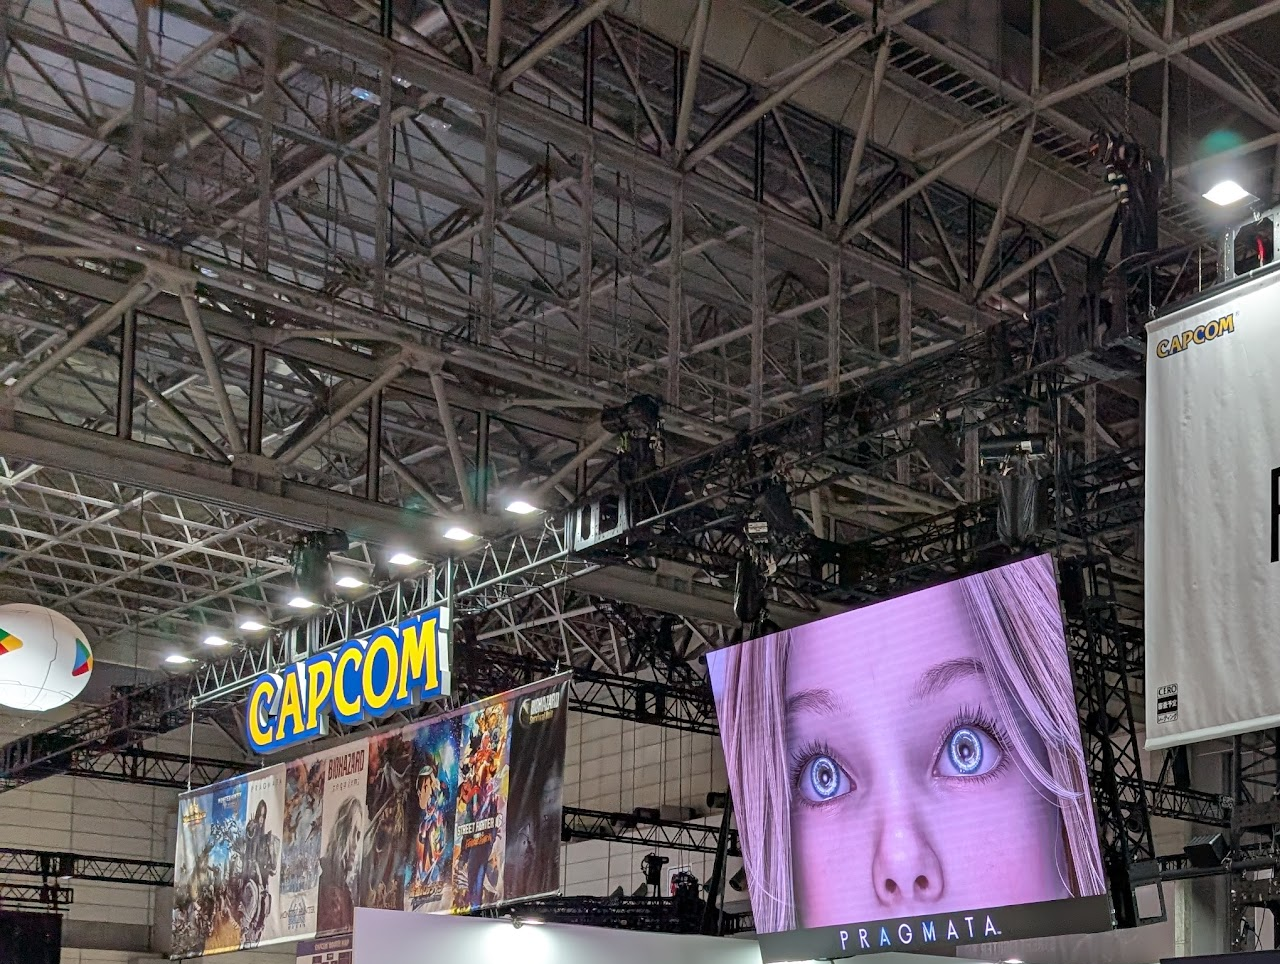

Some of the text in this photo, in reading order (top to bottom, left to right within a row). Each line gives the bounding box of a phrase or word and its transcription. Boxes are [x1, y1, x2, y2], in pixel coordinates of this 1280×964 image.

[1156, 312, 1235, 359] CAPCOM
[247, 611, 441, 750] CAPCOM
[328, 750, 365, 781] BIOHAZARD
[457, 822, 476, 837] STREET
[839, 916, 998, 951] PRAGMATA
